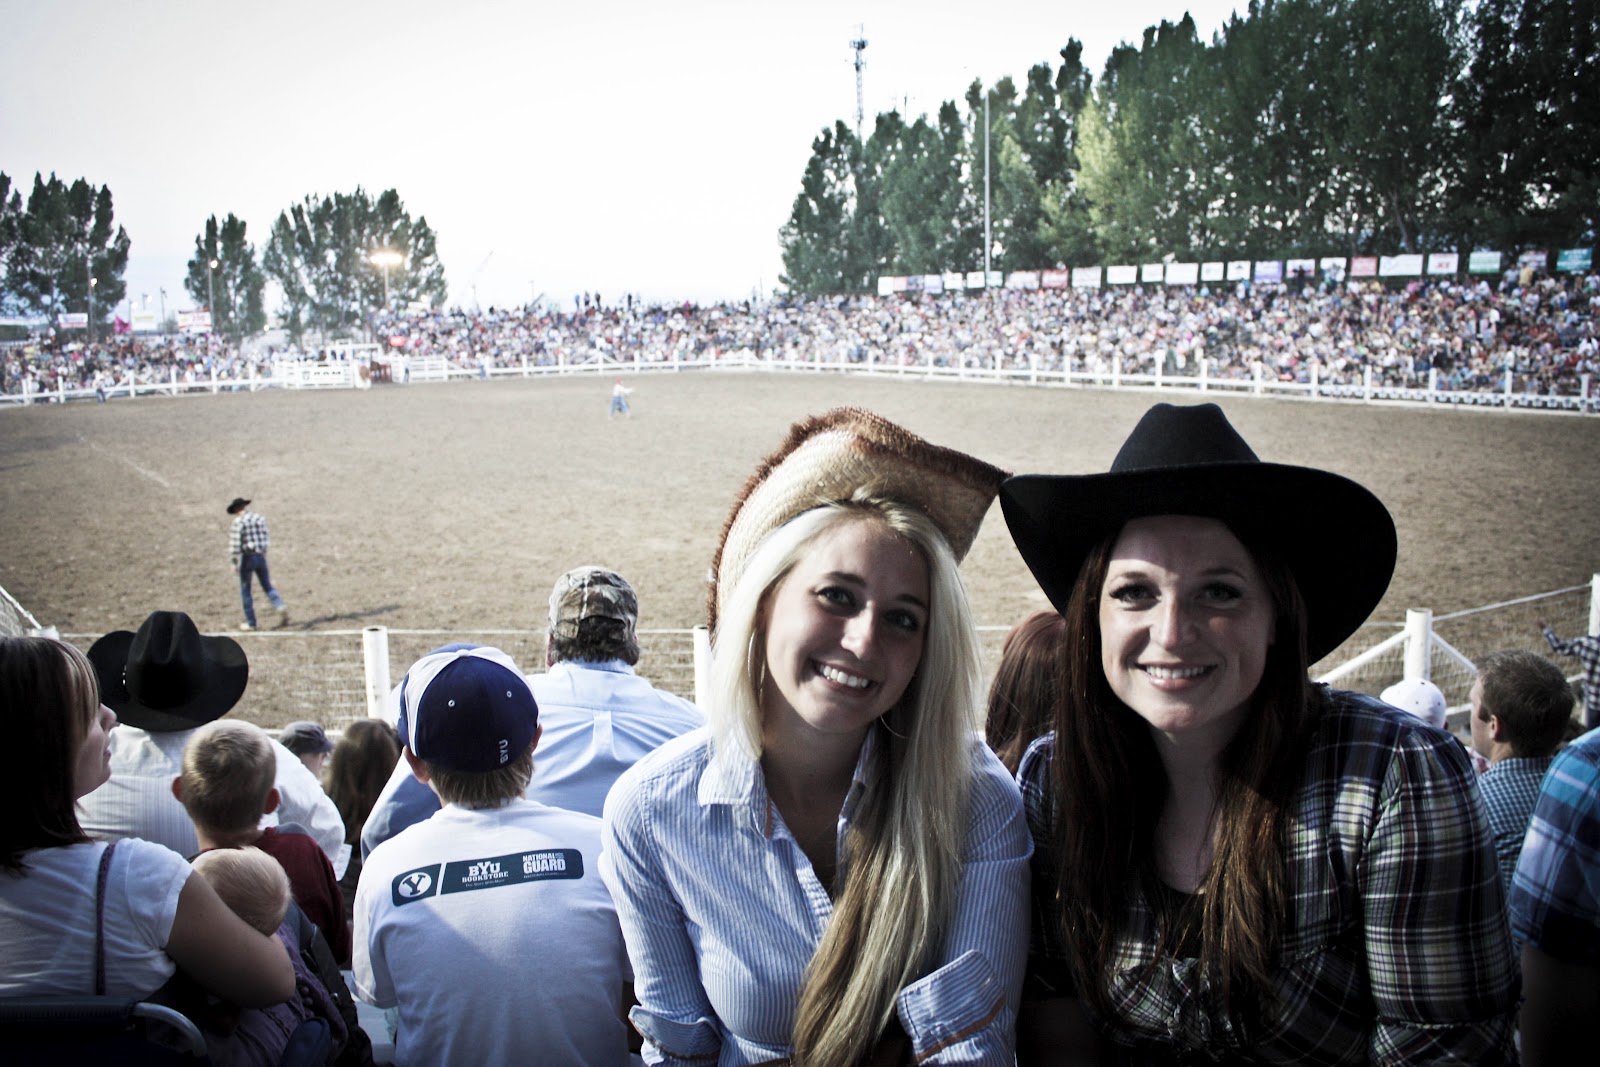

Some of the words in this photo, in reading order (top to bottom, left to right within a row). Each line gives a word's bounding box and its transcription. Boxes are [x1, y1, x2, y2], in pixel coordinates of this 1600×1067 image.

[498, 739, 509, 764] BYU
[522, 852, 556, 863] NATIONAL
[468, 860, 501, 876] BYU
[523, 858, 567, 874] GUARD
[402, 874, 426, 896] Y
[462, 871, 509, 883] BOOKSTORE
